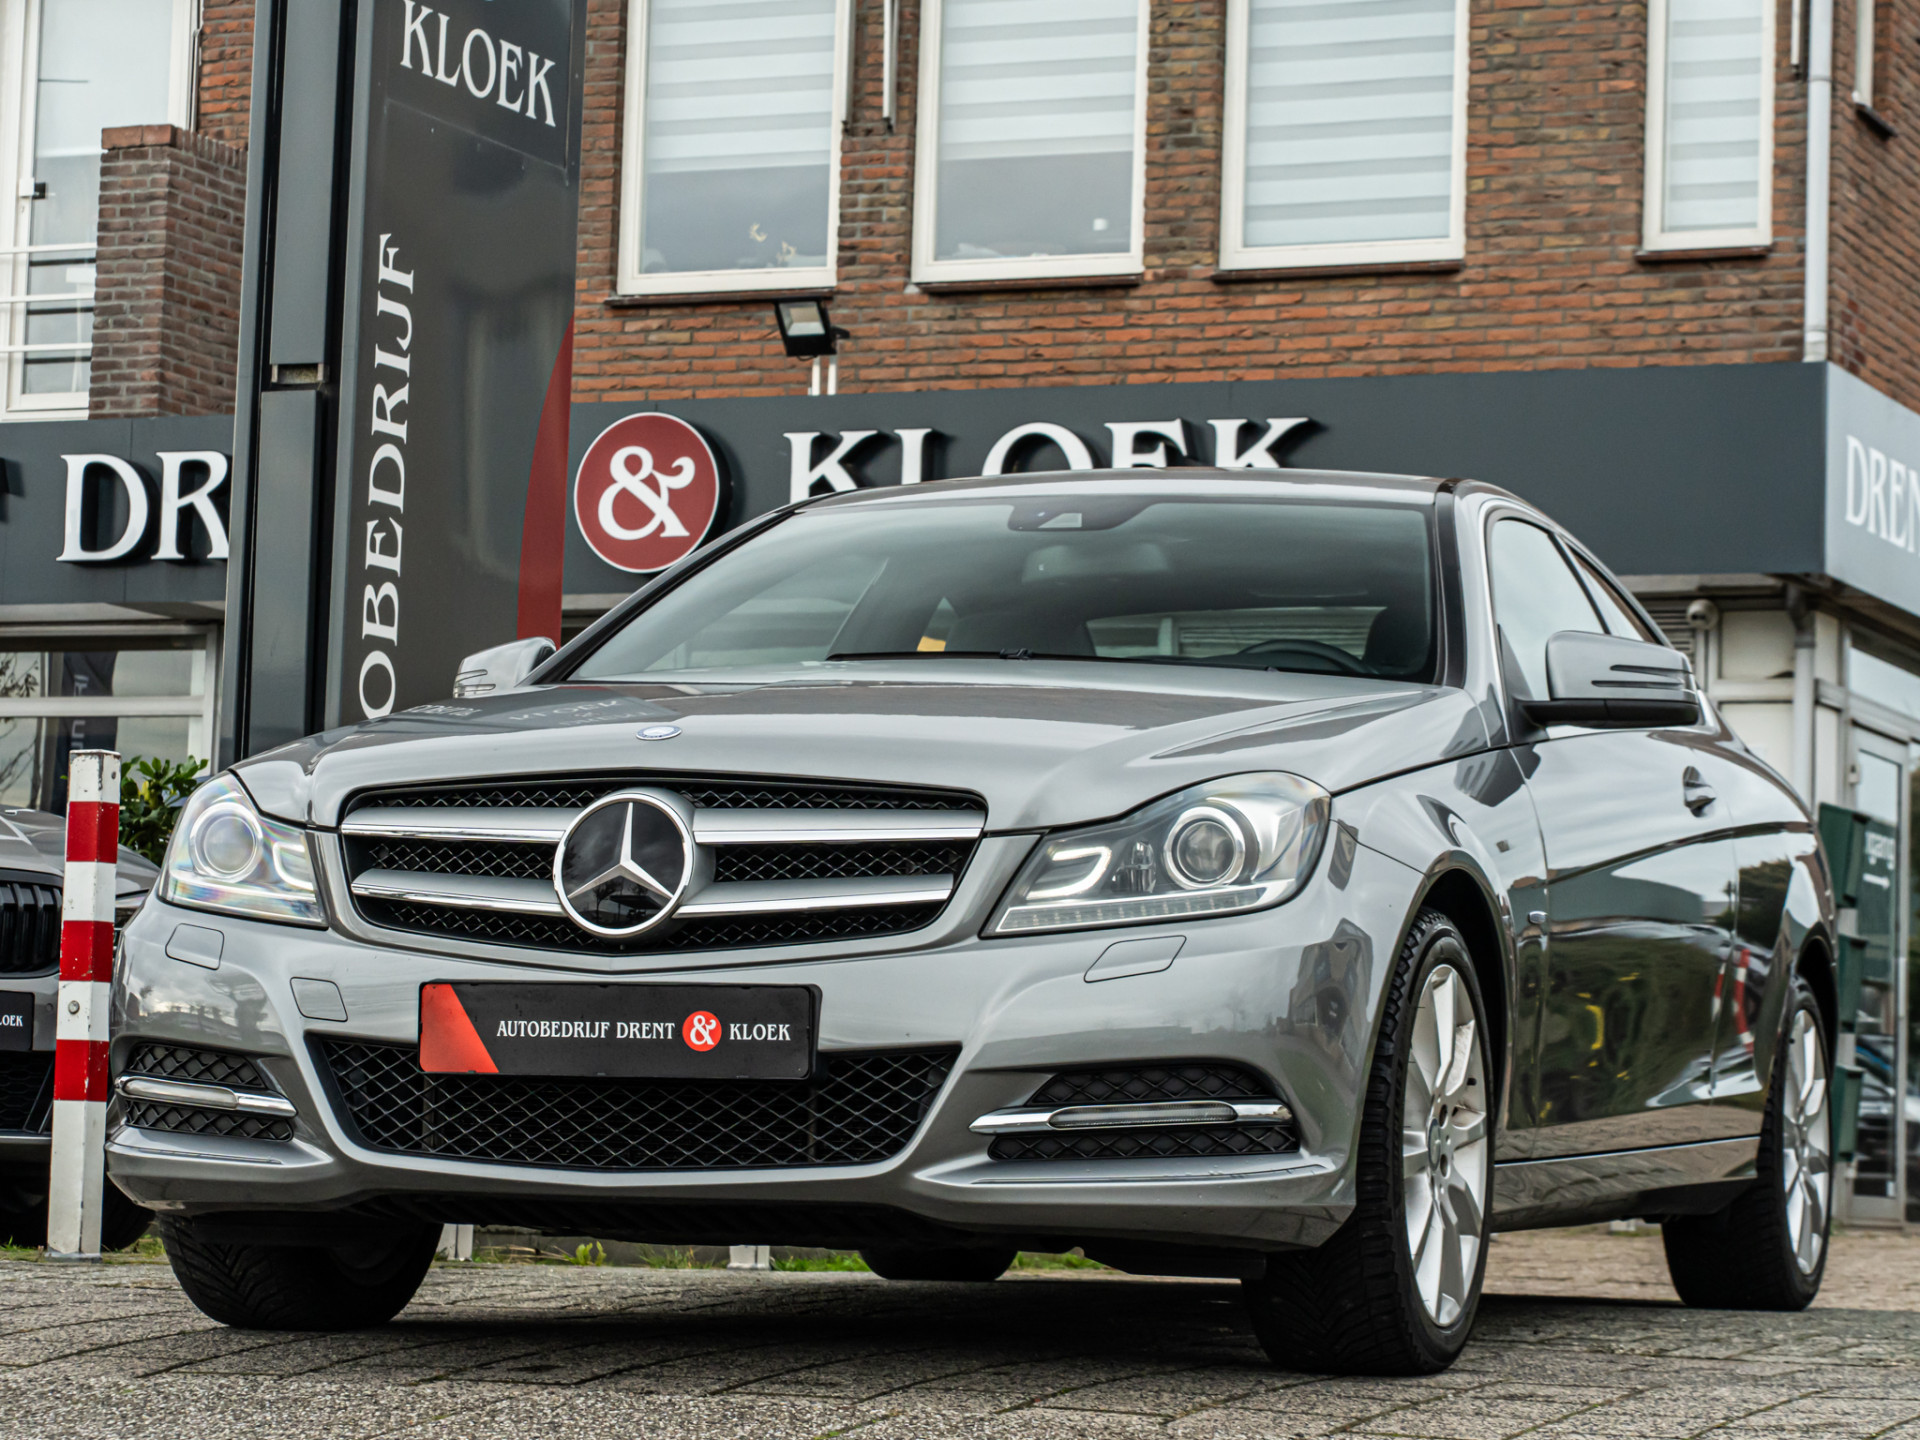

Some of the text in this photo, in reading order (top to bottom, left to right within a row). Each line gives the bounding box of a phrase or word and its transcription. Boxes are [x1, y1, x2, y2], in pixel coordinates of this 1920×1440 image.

[400, 0, 556, 128] KLOEK
[597, 445, 696, 540] &
[0, 1014, 23, 1027] OEK
[496, 1014, 791, 1046] AUTOBEDRIJF DRENT & KLOEK
